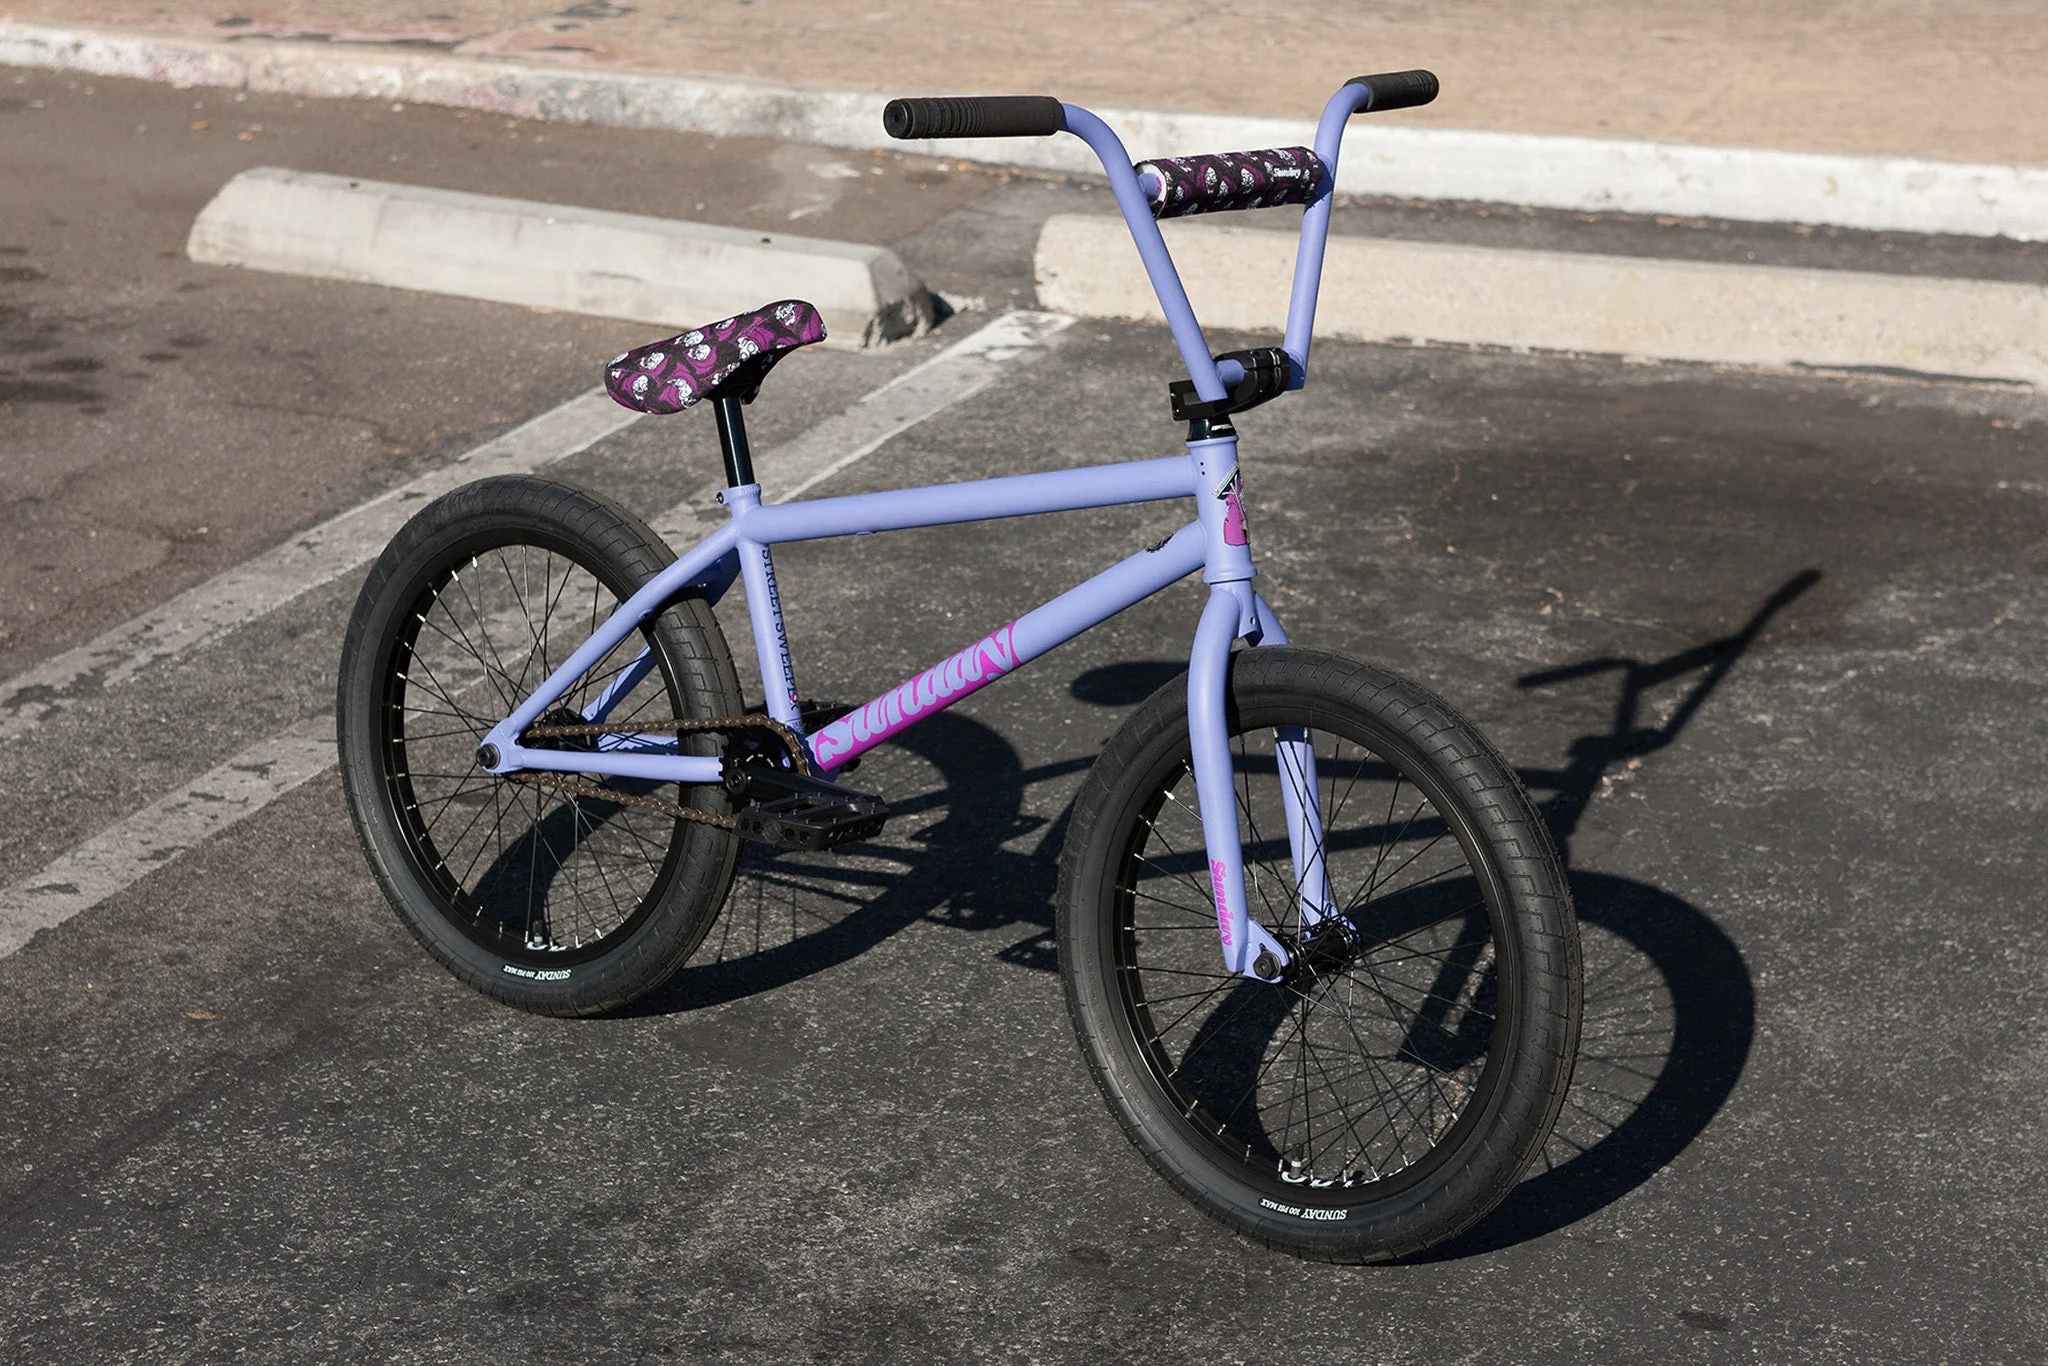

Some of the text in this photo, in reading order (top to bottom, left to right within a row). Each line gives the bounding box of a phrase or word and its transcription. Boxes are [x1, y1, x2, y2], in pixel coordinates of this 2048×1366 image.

[1273, 166, 1301, 179] Sunday
[1210, 858, 1234, 947] Sunday
[535, 969, 572, 980] SUNDAY
[1260, 1198, 1348, 1220] SUNDAY 100 PSI MAX
